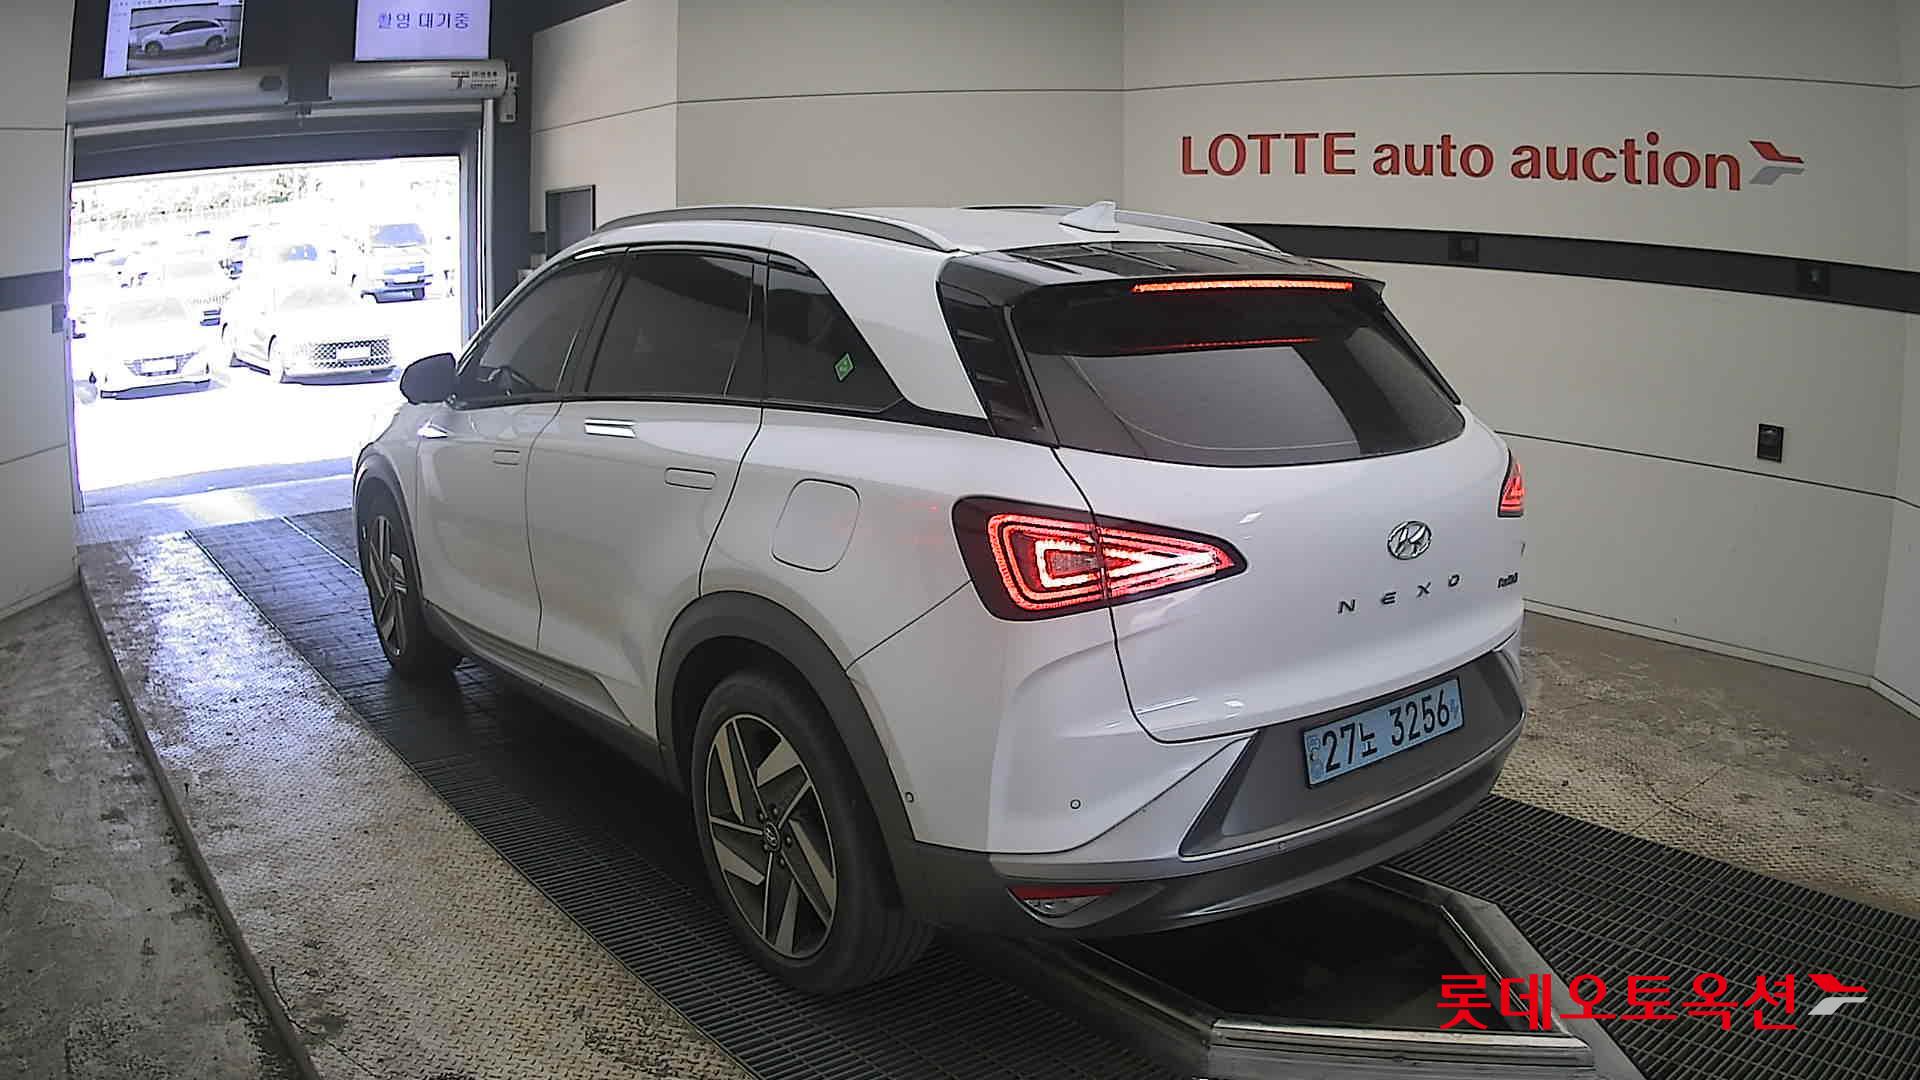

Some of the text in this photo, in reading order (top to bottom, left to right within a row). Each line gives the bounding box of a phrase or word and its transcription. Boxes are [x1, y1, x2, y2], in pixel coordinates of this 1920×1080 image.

[418, 12, 469, 29] 대기중
[1182, 131, 1741, 191] LOTTE auto auction
[1337, 574, 1460, 614] NEXO
[1322, 722, 1378, 773] 27노
[1389, 689, 1450, 746] 3256
